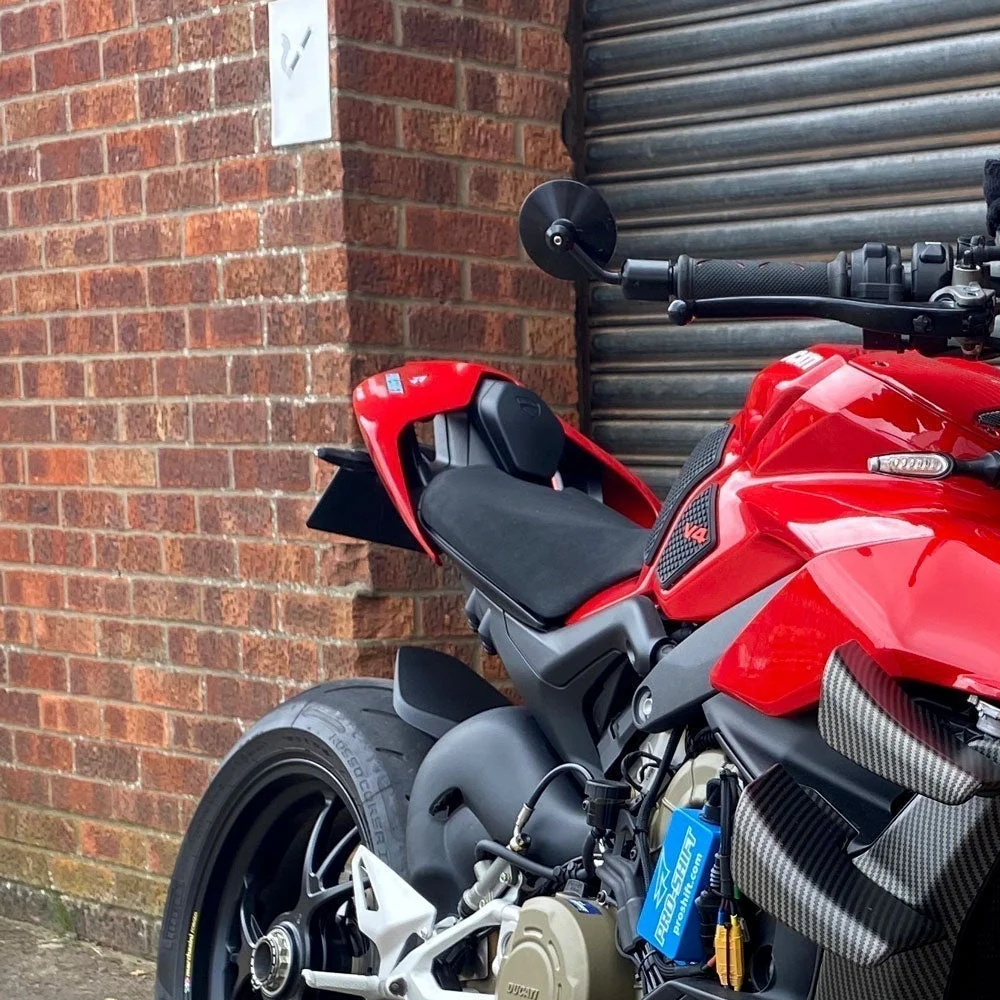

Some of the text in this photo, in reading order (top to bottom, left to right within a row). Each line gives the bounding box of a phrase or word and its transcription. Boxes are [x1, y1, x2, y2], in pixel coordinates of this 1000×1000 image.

[684, 523, 708, 544] V4
[654, 825, 697, 947] PRO-SHIFT
[673, 853, 703, 937] proshift.com
[507, 982, 540, 1000] DUCATI
